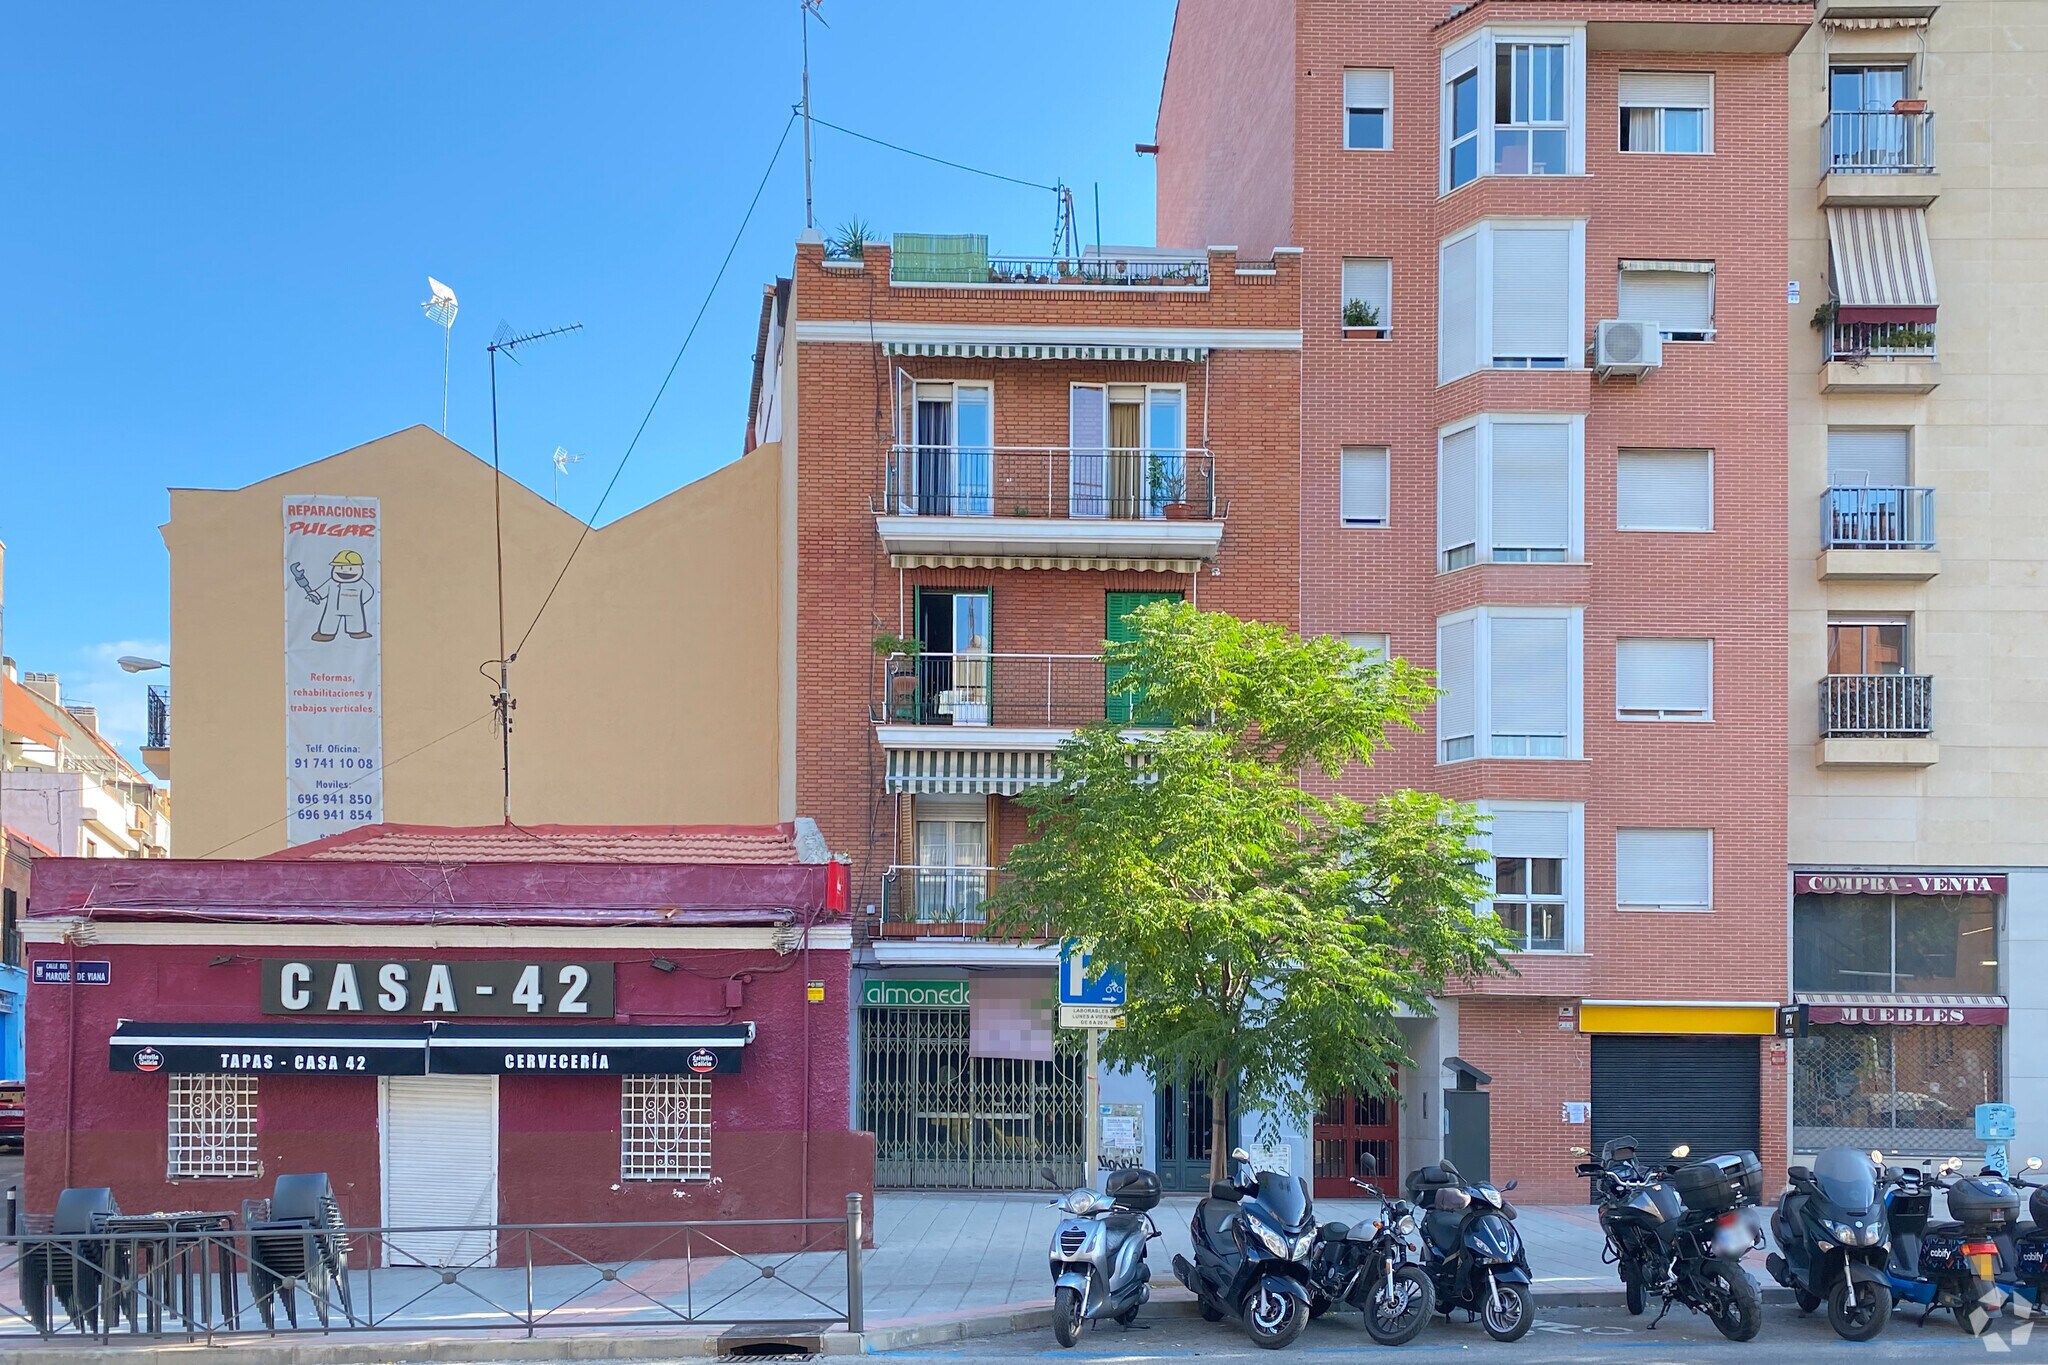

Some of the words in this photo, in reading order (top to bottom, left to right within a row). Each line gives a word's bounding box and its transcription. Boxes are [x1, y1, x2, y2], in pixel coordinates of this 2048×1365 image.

[287, 505, 377, 519] REPARACIONES
[288, 521, 376, 538] PULGAR
[310, 672, 355, 684] Reformas,
[293, 688, 365, 698] rehabilitaciones
[367, 690, 373, 700] y
[290, 704, 327, 715] trabajos
[330, 705, 376, 714] verticales.
[305, 744, 324, 753] Telf.
[327, 744, 361, 753] Oficina:
[294, 758, 308, 769] 91
[313, 758, 334, 769] 741
[340, 759, 354, 769] 10
[358, 759, 373, 769] 08
[297, 794, 319, 805] 696
[323, 794, 344, 805] 941
[349, 795, 373, 805] 850
[297, 810, 320, 821] 696
[323, 810, 345, 821] 941
[350, 810, 373, 821] 854
[1808, 876, 1899, 891] COMPRA
[1918, 877, 1992, 891] VENTA
[46, 970, 71, 982] MARQUÉ
[77, 972, 85, 981] DE
[88, 972, 106, 981] VIANA
[280, 962, 458, 1012] CASA
[476, 985, 493, 995] -
[512, 964, 589, 1013] 42
[1841, 1008, 1964, 1022] MUEBLES
[220, 1053, 273, 1069] TAPAS
[294, 1055, 338, 1070] CASA
[345, 1055, 366, 1070] 42
[504, 1052, 609, 1069] CERVECERÍA
[1930, 1248, 1951, 1260] cabify
[2023, 1252, 2043, 1263] cabify
